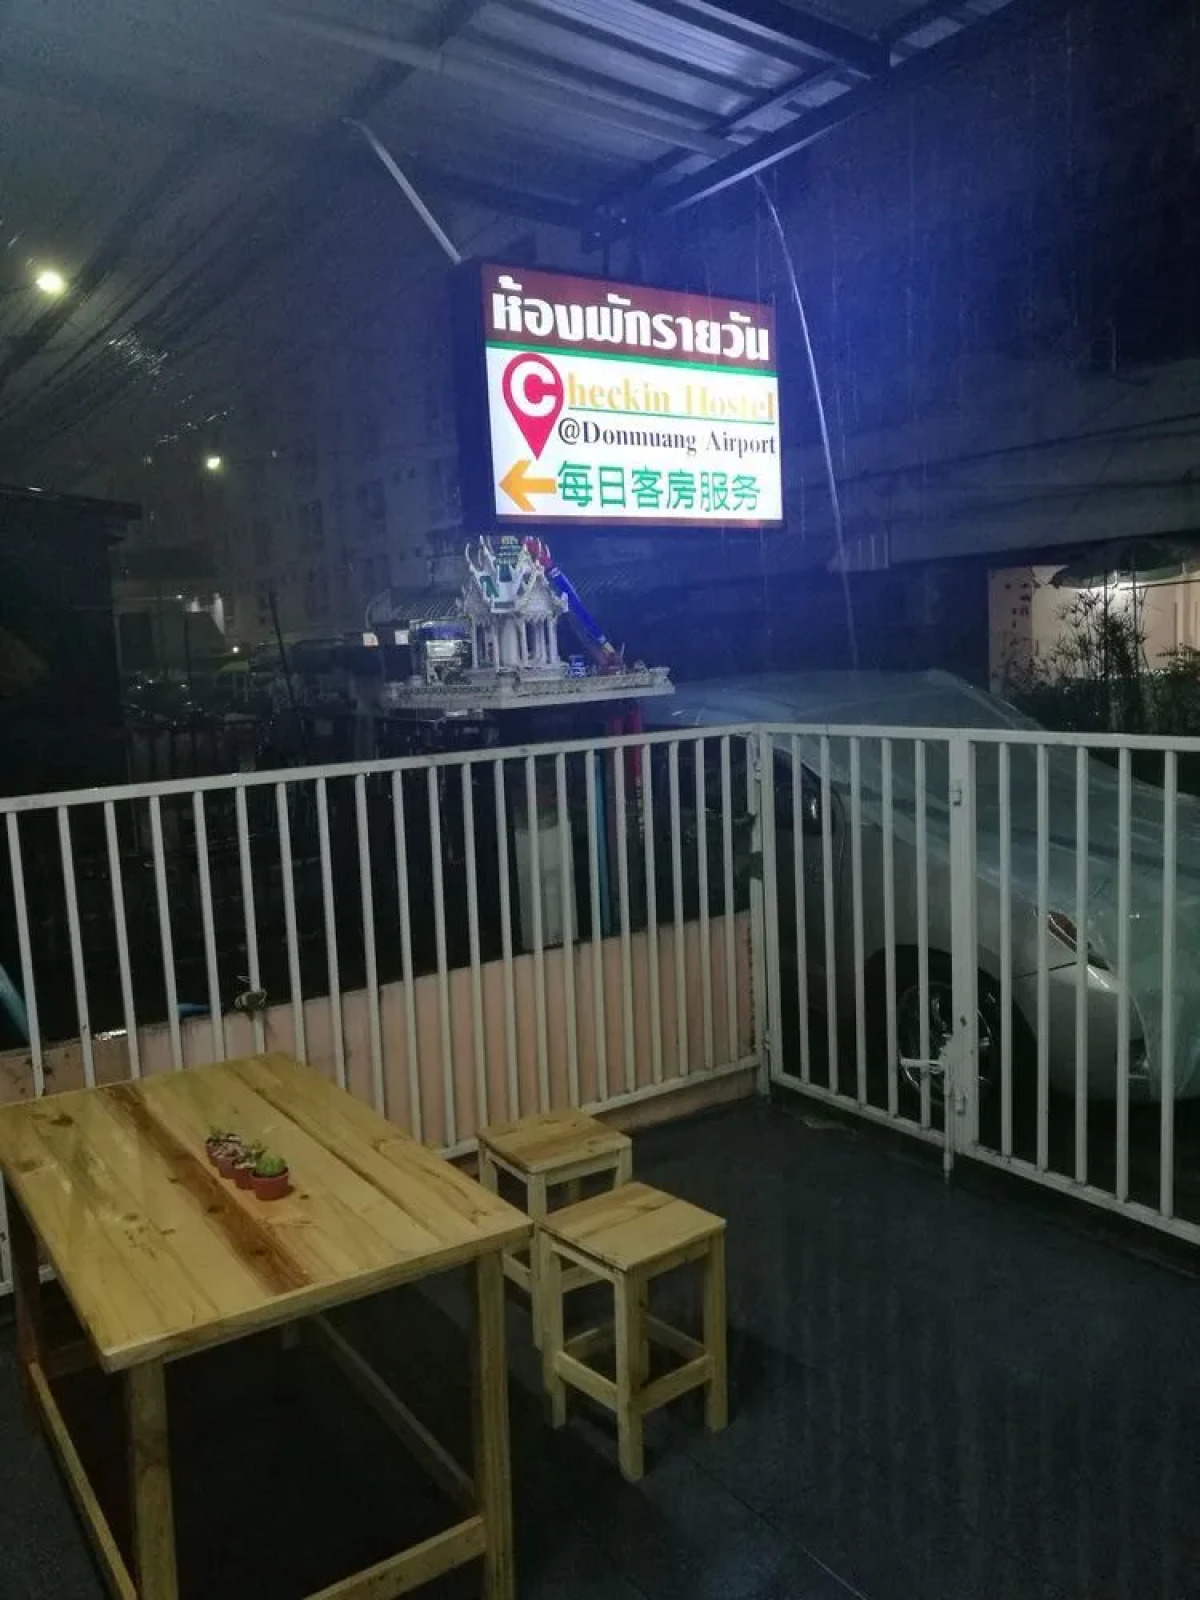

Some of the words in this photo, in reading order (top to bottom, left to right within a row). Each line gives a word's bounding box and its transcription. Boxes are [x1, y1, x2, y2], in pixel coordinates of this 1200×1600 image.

[492, 275, 769, 361] ห้องพักรายวัน
[685, 384, 775, 422] Hostel
[557, 417, 697, 457] @Donmuang
[705, 430, 776, 458] Airport
[557, 460, 761, 513] 每日客房服务
